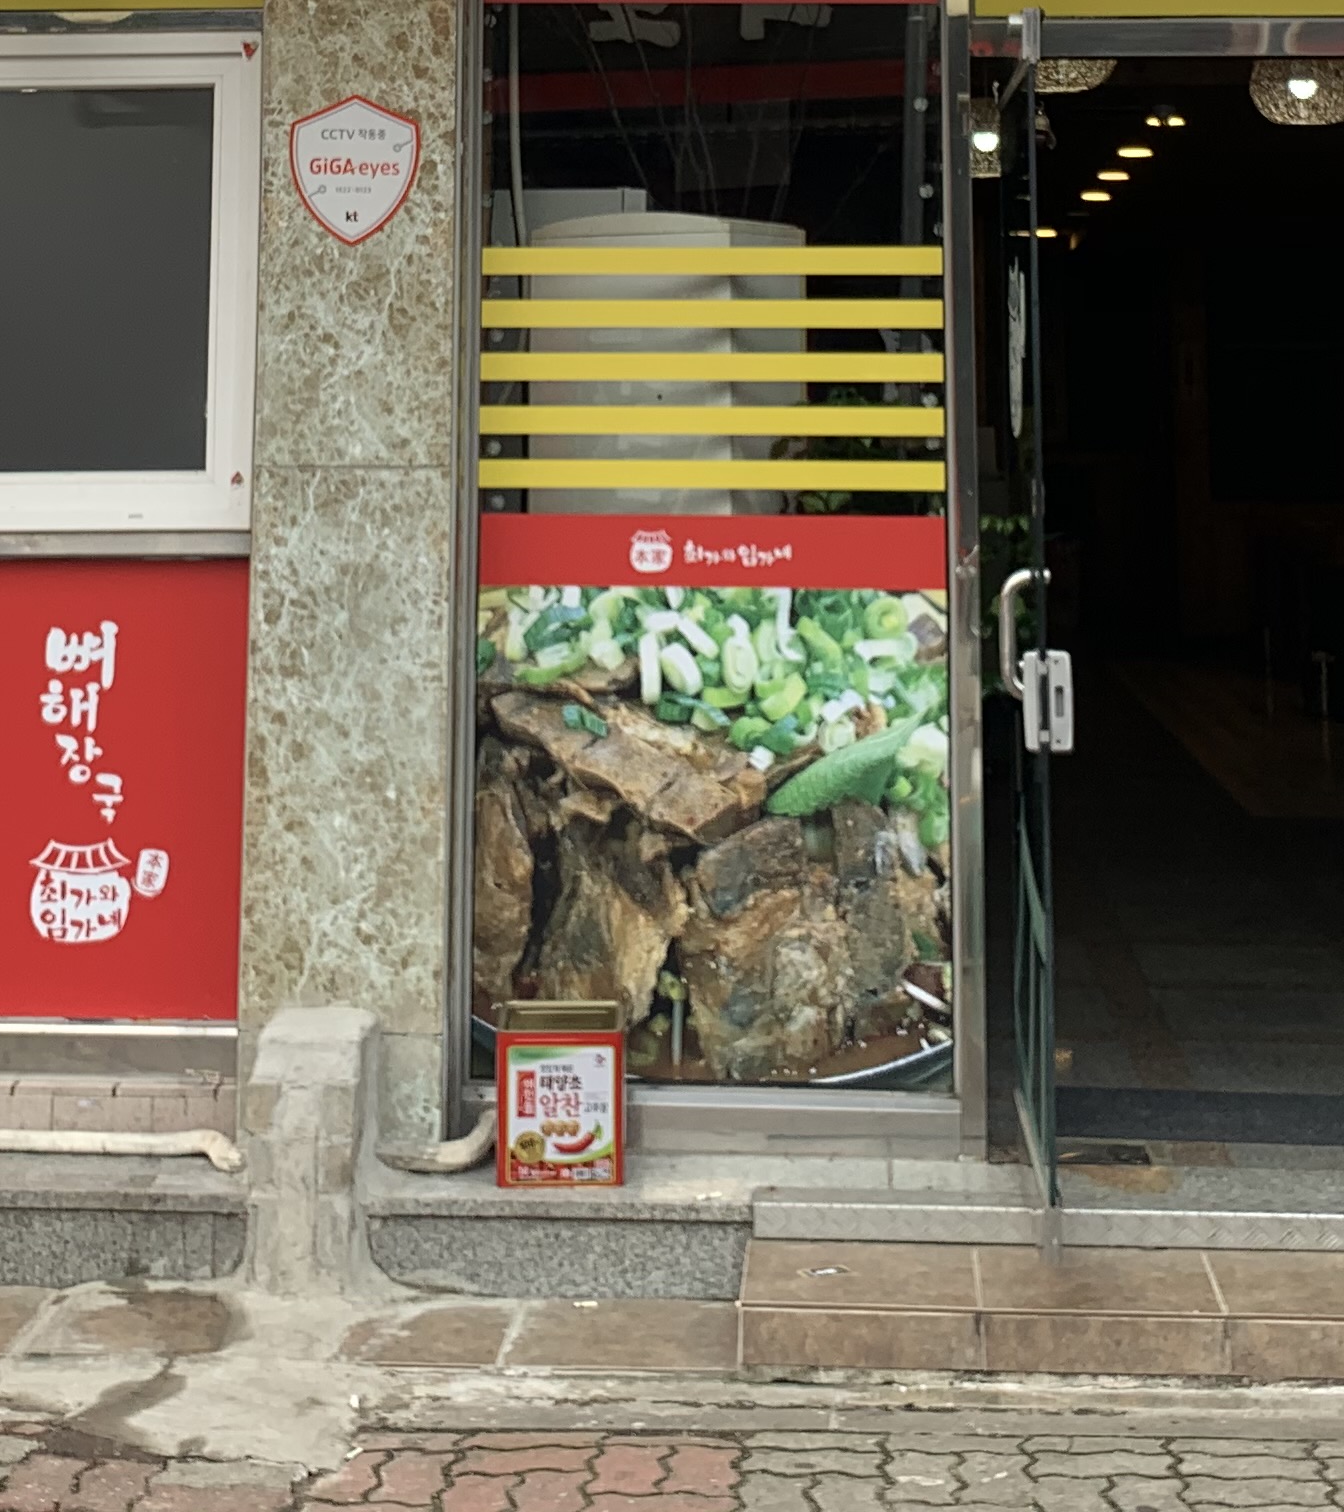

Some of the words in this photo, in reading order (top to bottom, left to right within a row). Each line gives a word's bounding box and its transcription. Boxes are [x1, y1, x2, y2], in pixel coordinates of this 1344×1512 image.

[321, 129, 355, 140] CCTV
[358, 129, 386, 140] 작동중
[345, 211, 358, 222] kt
[40, 870, 118, 906] 최가와
[40, 909, 122, 938] 임가네
